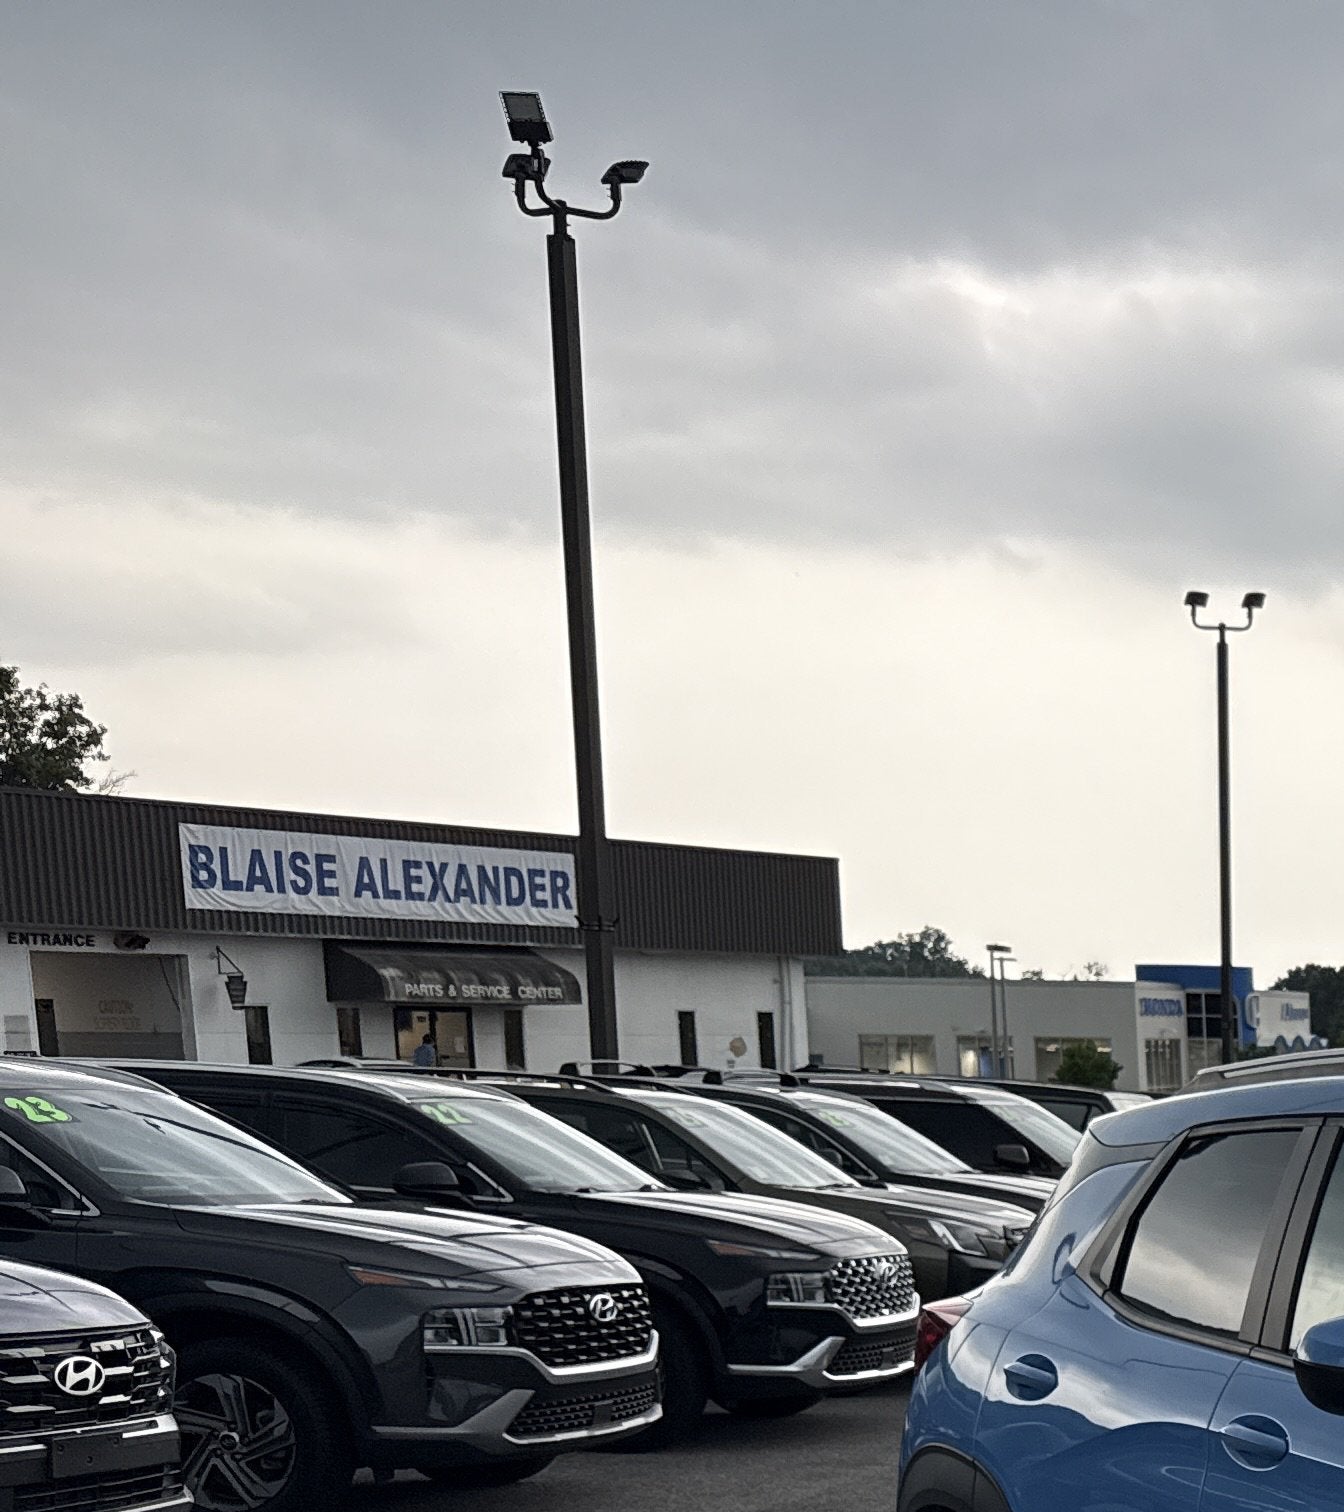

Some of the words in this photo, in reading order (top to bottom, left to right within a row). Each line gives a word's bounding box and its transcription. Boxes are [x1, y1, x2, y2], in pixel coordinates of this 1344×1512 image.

[187, 843, 340, 898] BLAISE
[354, 855, 574, 911] ALEXANDER
[7, 931, 96, 948] ENTRANCE
[404, 983, 444, 998] PARTS
[448, 983, 457, 997] &
[461, 984, 513, 999] SERVICE
[517, 986, 563, 1000] CENTER
[4, 1096, 69, 1123] 23
[420, 1104, 473, 1125] 22
